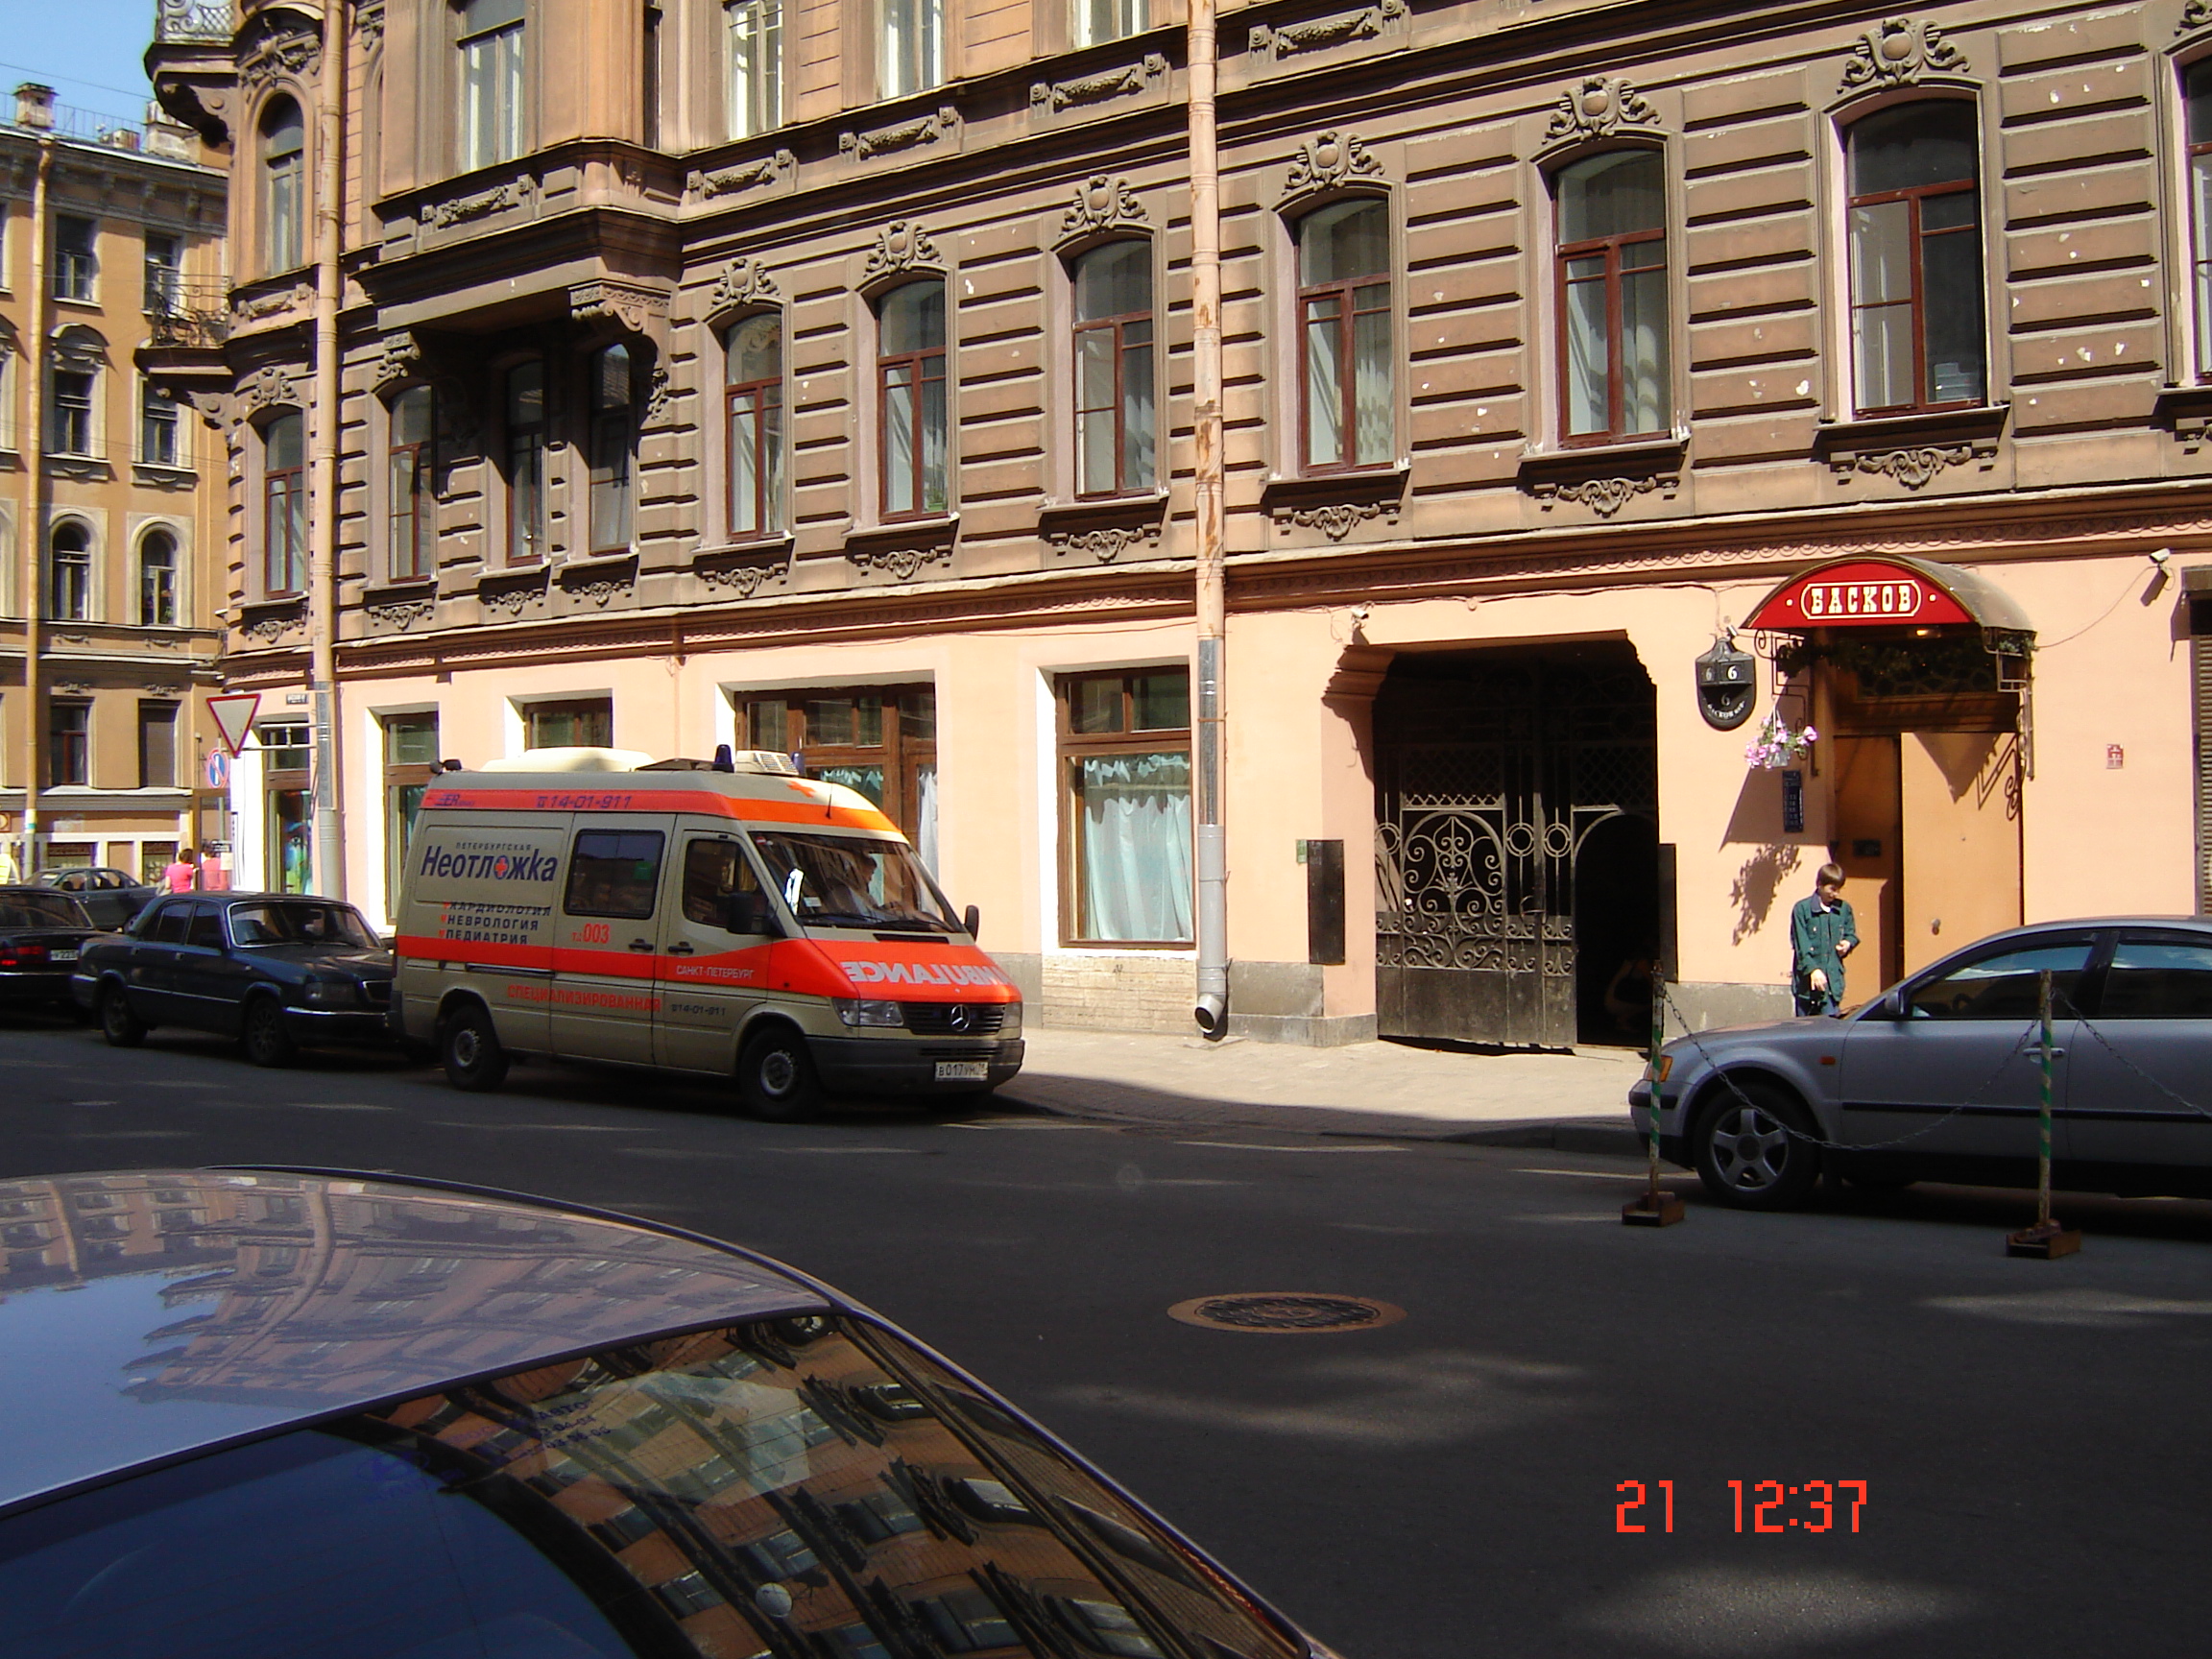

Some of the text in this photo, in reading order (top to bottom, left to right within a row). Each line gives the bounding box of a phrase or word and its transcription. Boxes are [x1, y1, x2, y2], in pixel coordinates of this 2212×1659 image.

[1811, 585, 1911, 614] БАСКОВ
[1705, 667, 1713, 682] 6
[1727, 665, 1739, 681] 6
[1720, 693, 1731, 707] 6
[550, 795, 633, 809] 14-01-911
[421, 845, 559, 882] Неотложка
[447, 914, 540, 931] НЕВРОЛОГИЯ
[445, 929, 528, 946] ПЕДИАТРИЯ
[676, 965, 755, 979] САНКТ-ПЕТЕРБУРГ
[507, 984, 661, 1012] СПЕЦИАЛИЗИРОВАННАЯ
